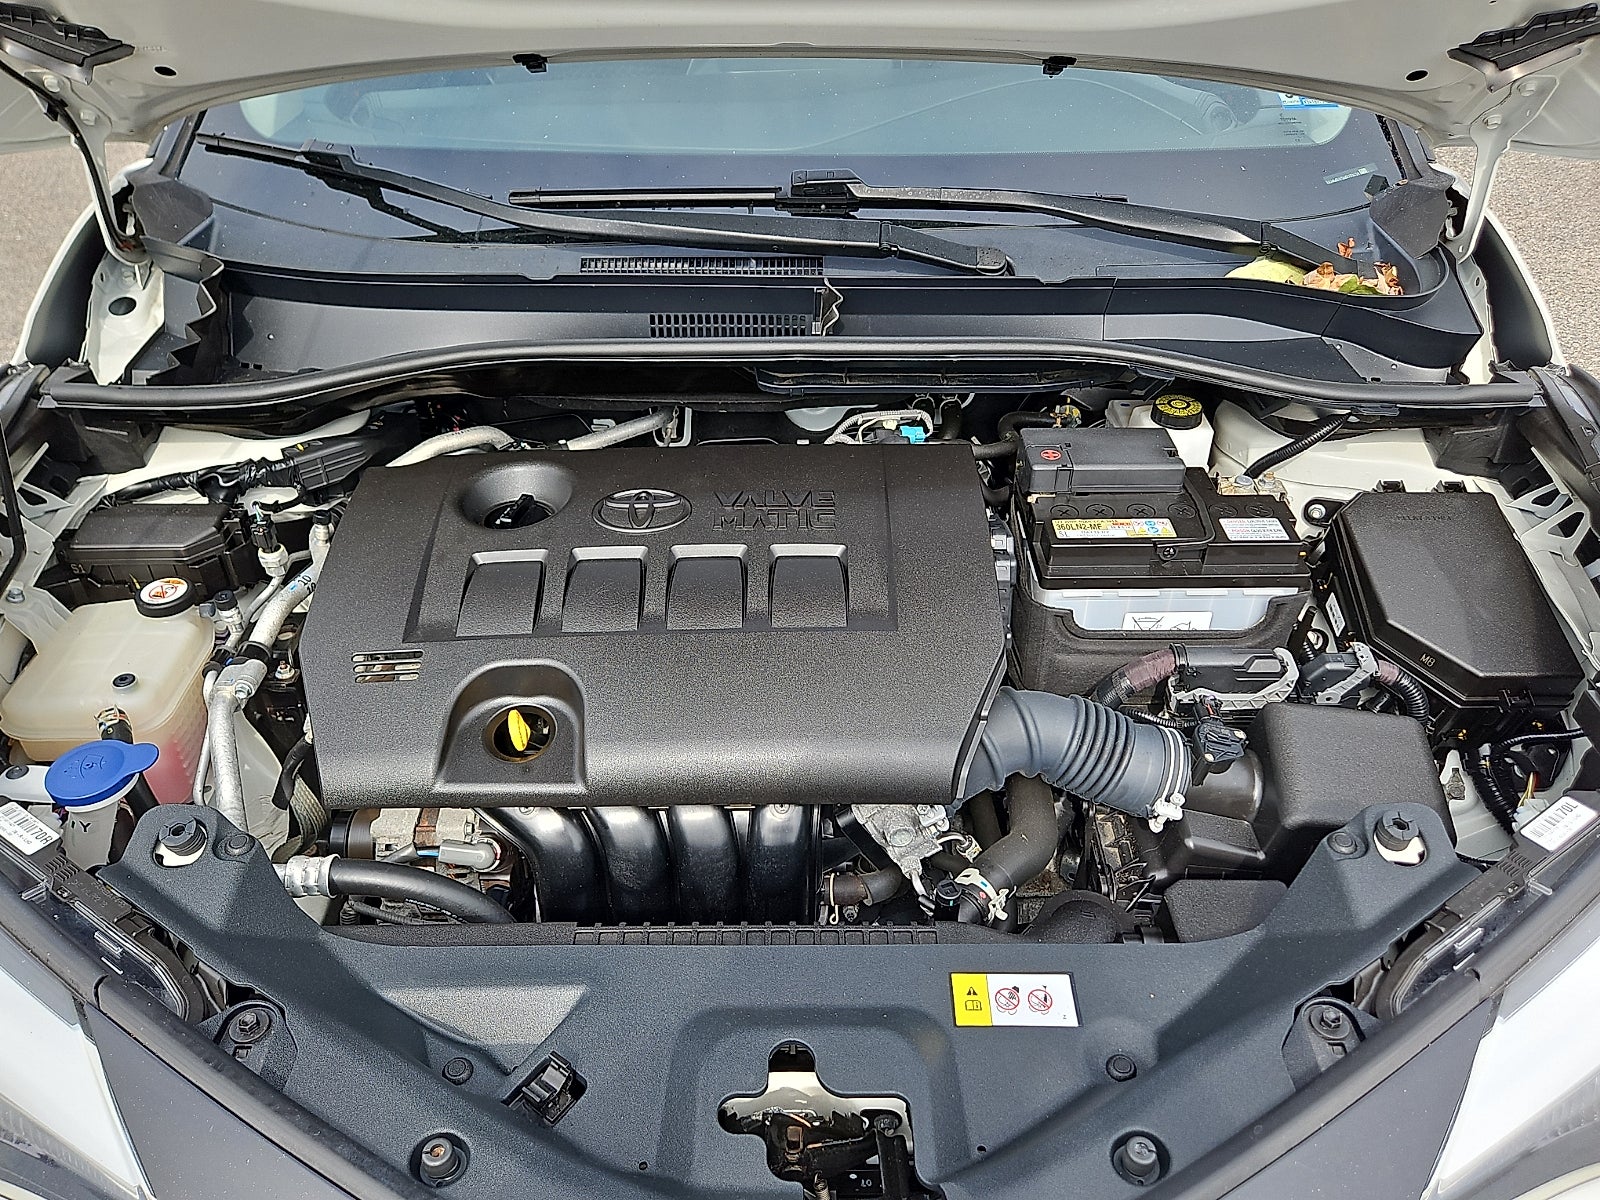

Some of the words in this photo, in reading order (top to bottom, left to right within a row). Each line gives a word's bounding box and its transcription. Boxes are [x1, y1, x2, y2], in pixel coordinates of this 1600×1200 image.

[713, 490, 835, 507] VALVE
[712, 508, 836, 530] MATIC
[1056, 523, 1102, 531] 360LN2-MF
